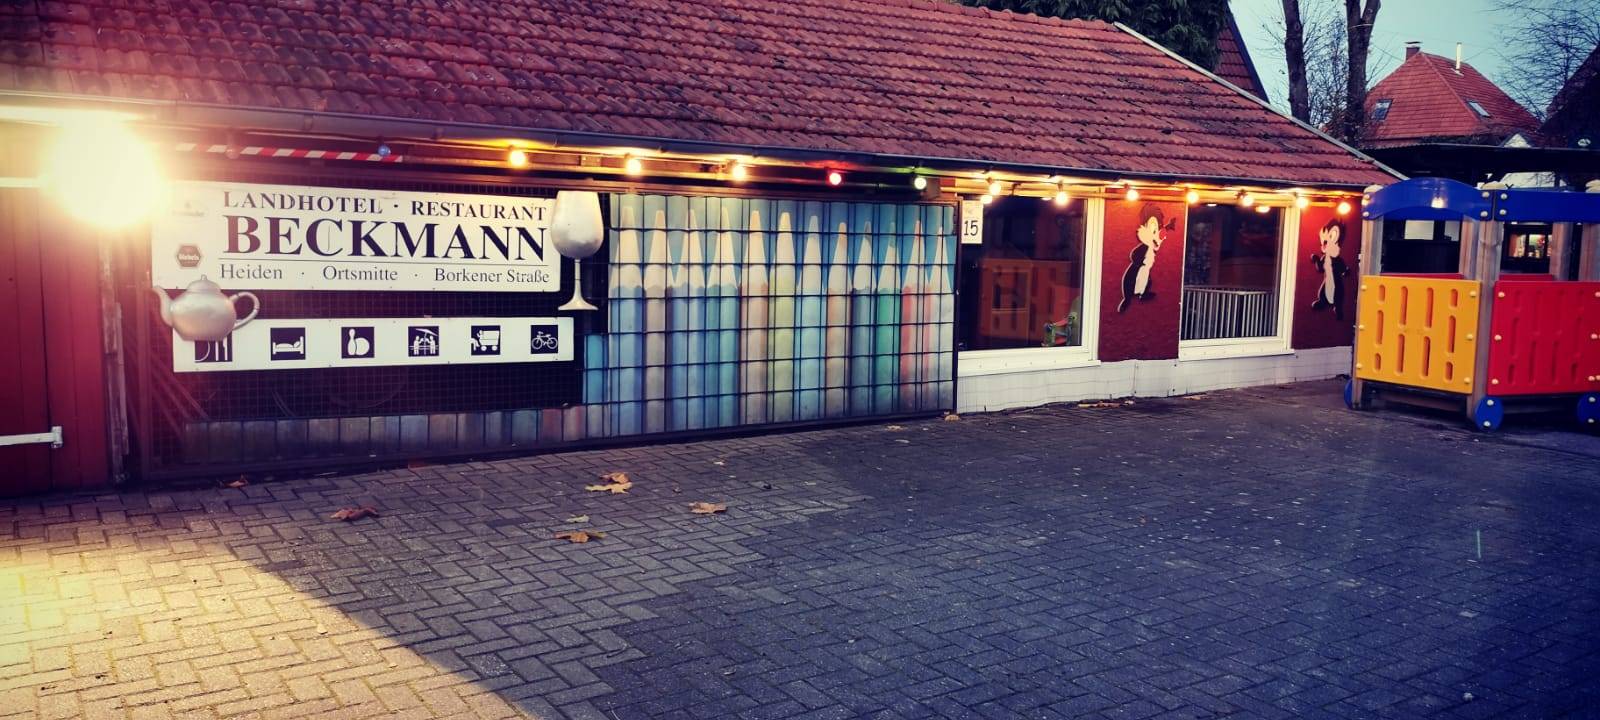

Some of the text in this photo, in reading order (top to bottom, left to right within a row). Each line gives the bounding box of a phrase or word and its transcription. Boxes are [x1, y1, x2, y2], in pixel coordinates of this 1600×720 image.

[224, 191, 546, 221] LANDHOTEL RESTAURANT
[223, 215, 547, 262] BECKMANN
[963, 220, 979, 237] 15
[220, 263, 550, 284] Heiden Ortsmitte Borkener Straße
